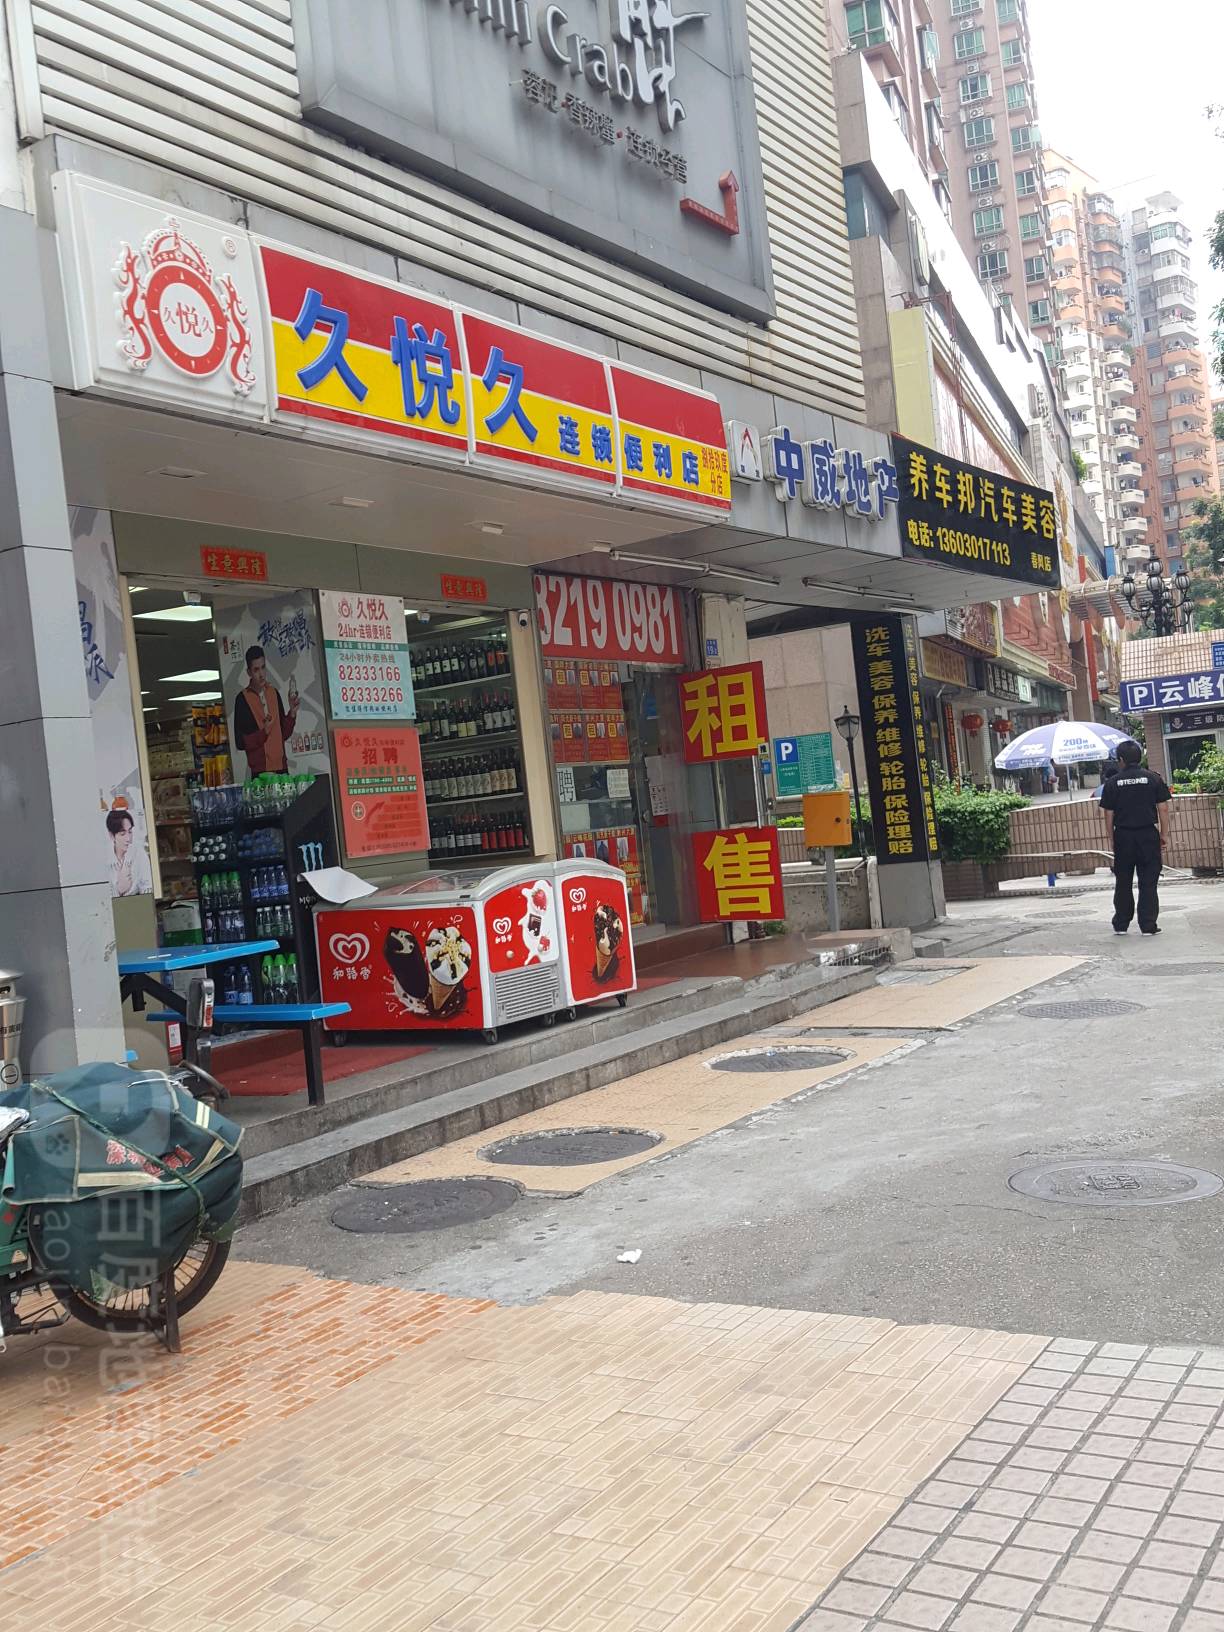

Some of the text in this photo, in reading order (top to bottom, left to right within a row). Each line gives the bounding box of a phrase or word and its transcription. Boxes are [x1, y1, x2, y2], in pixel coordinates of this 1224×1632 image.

[538, 4, 633, 101] Crab
[164, 302, 214, 338] 久悦久
[294, 287, 538, 443] 久悦久
[558, 415, 700, 486] 连锁便利店
[710, 472, 724, 495] 分店
[770, 426, 900, 522] 中威地产
[909, 451, 1056, 539] 养车邦汽车美容
[1030, 552, 1052, 572] 春风店
[356, 598, 389, 621] 久悦久
[612, 580, 679, 655] 0981
[338, 664, 401, 682] 82333166
[341, 686, 404, 703] 82333266
[1133, 686, 1149, 706] P
[683, 670, 766, 758] 租
[362, 747, 399, 765] 招聘
[780, 742, 793, 761] P
[703, 832, 776, 917] 售
[332, 965, 372, 980] 和路雪
